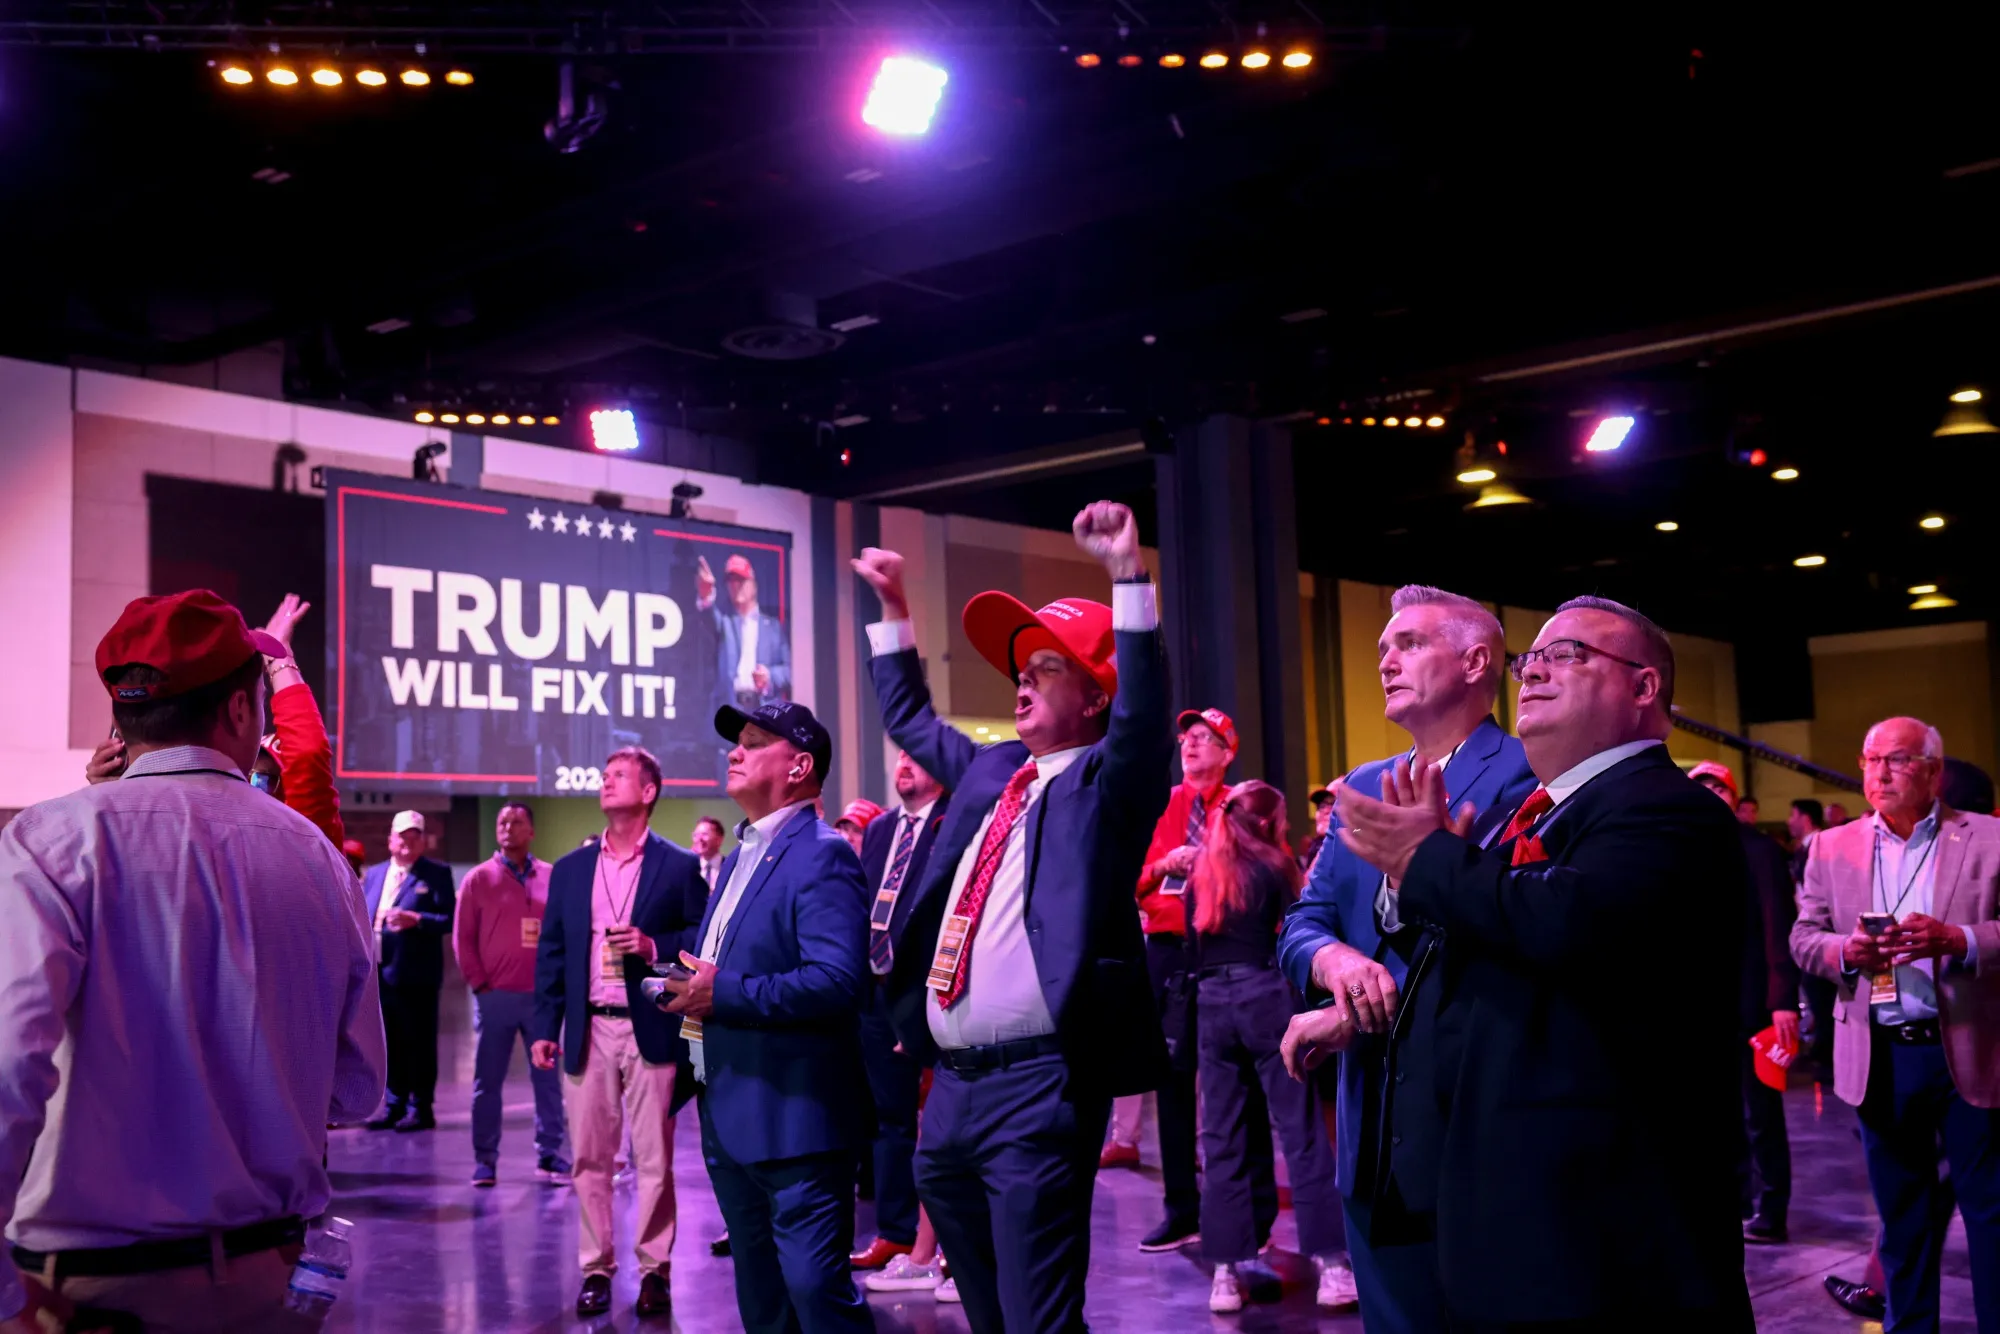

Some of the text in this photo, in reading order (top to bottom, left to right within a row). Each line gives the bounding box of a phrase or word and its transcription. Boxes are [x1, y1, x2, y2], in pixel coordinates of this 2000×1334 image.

[371, 564, 684, 667] TRUMP
[381, 656, 676, 719] WILL FIX IT!
[555, 766, 604, 791] 202
